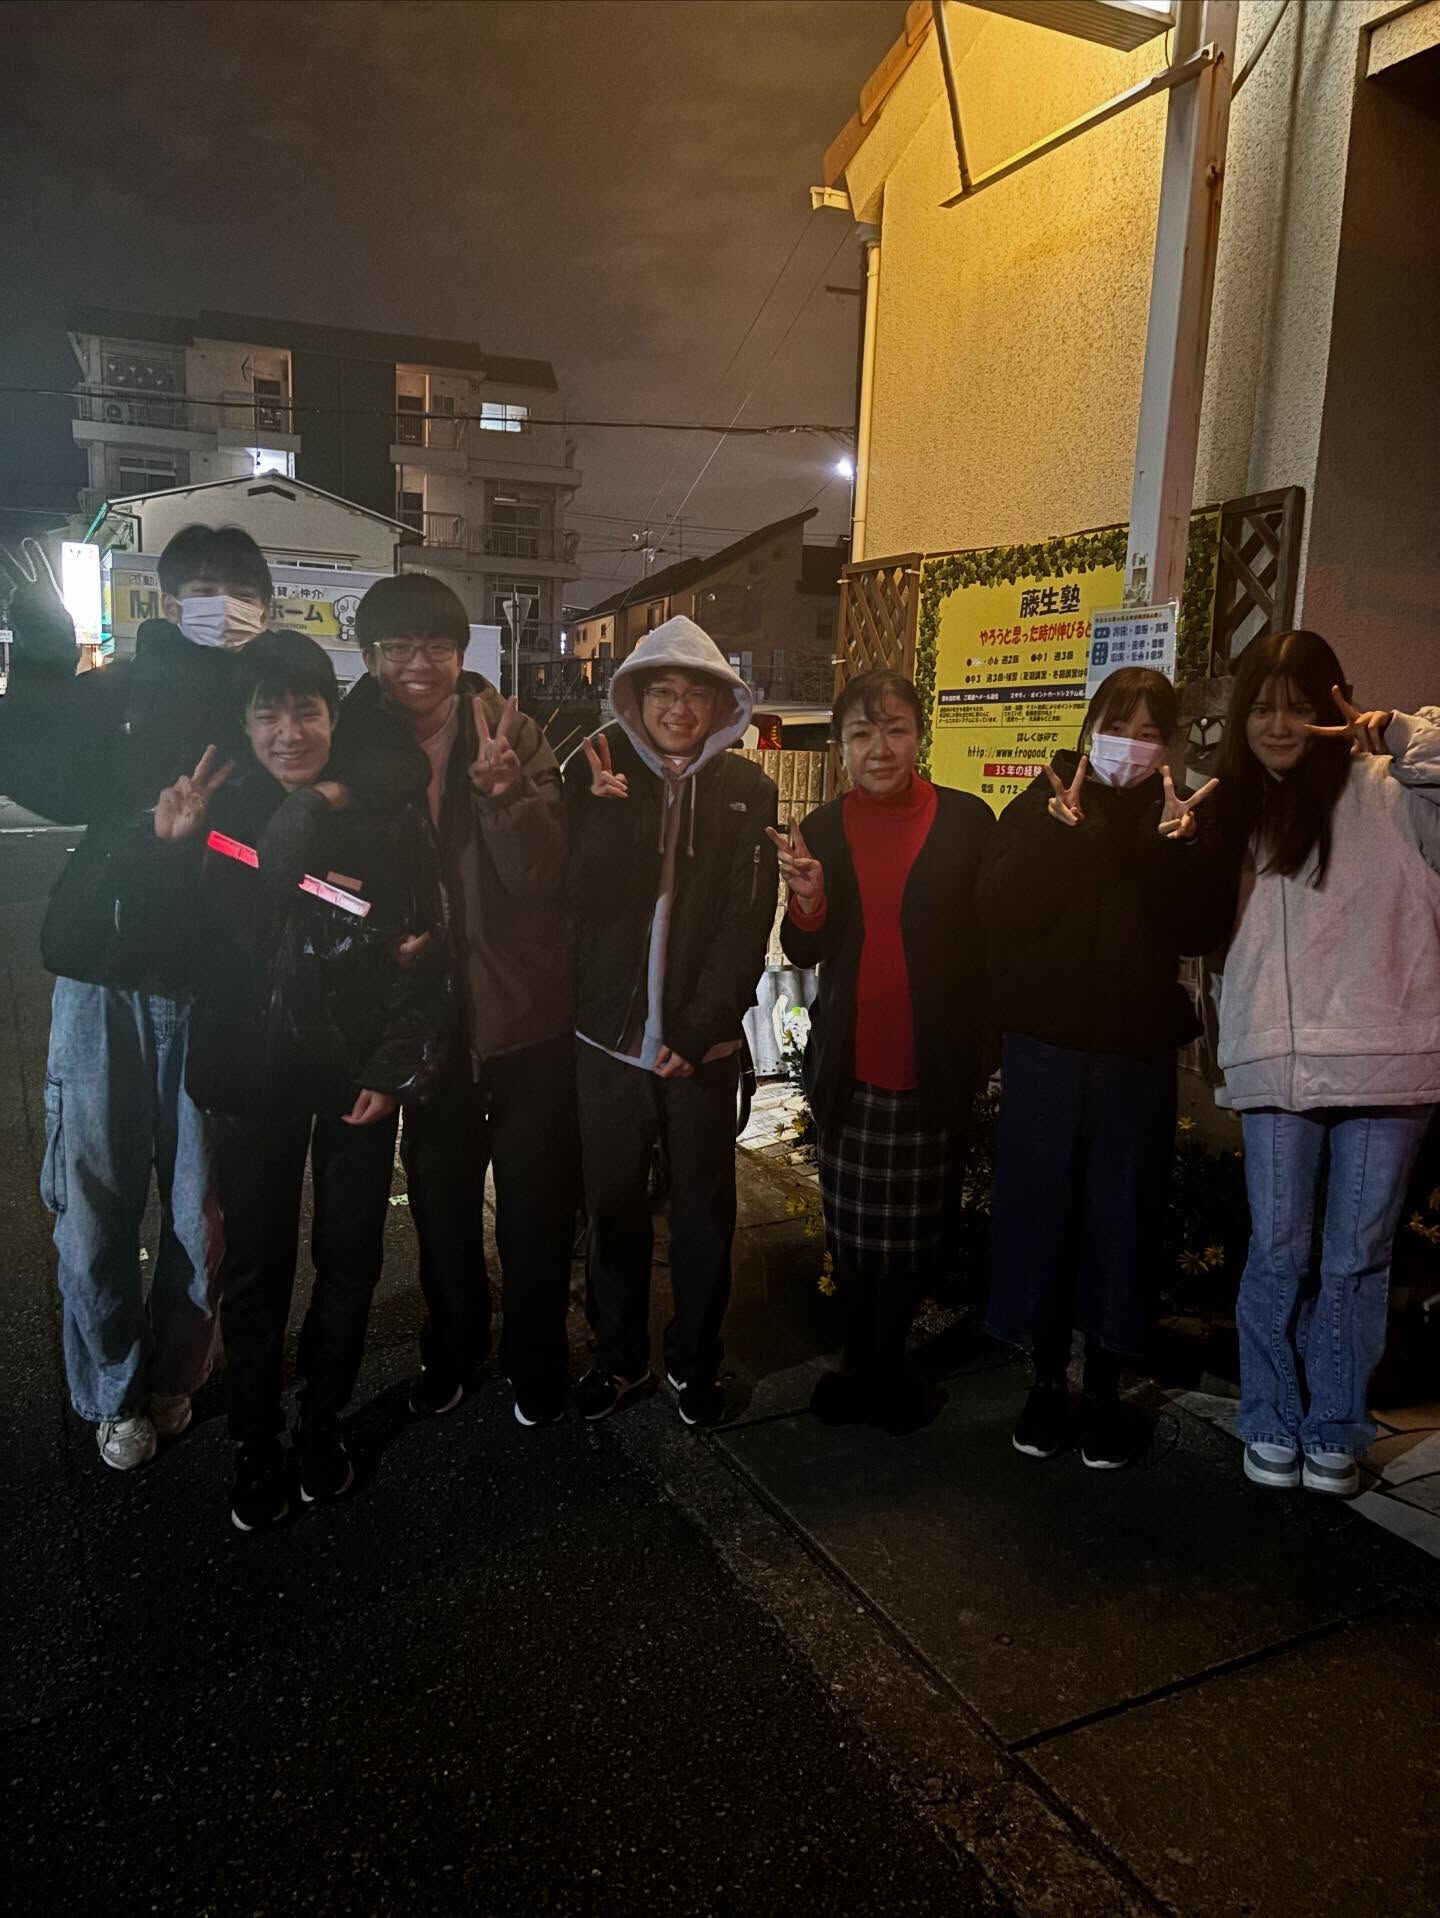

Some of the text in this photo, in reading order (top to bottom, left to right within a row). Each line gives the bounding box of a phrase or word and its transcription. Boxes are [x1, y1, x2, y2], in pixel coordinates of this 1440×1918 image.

[272, 586, 323, 599] 貸・仲介
[1019, 584, 1081, 618] 藤生塾
[269, 601, 324, 623] ホーム
[981, 784, 1025, 795] 電話 072-
